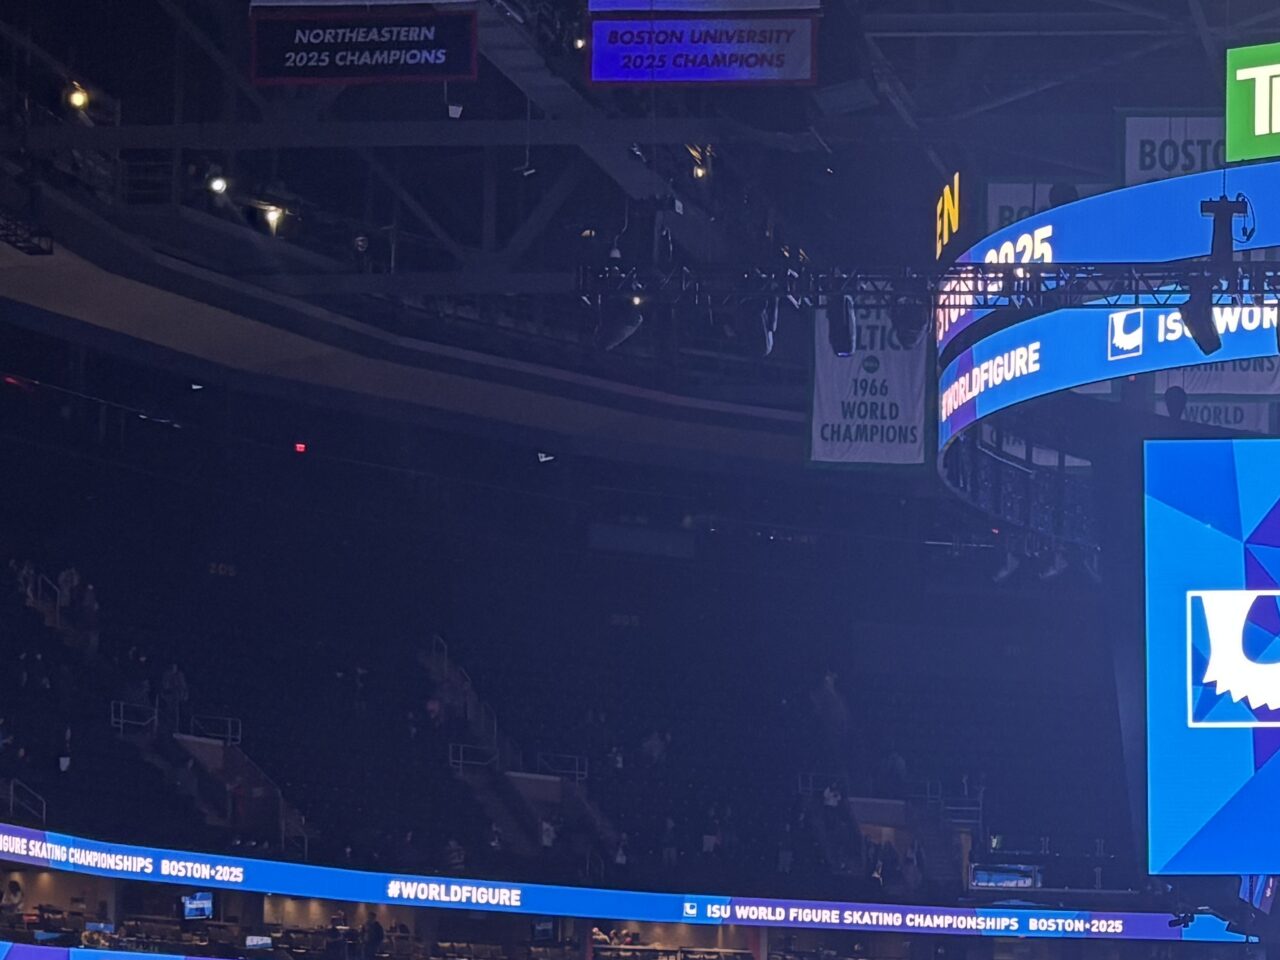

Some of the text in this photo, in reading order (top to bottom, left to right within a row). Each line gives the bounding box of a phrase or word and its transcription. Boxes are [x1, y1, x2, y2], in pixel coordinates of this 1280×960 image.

[294, 26, 435, 45] NORTHEASTERN
[607, 27, 795, 46] BOSTON UNIVERSITY
[284, 48, 447, 68] 2025 CHAMPIONS
[621, 51, 786, 70] 2025 CHAMPIONS
[1139, 139, 1225, 170] BOSTO
[853, 378, 888, 397] 1966
[841, 401, 899, 420] WORLD
[820, 423, 918, 444] CHAMPIONS
[28, 839, 67, 862] SKATING
[69, 847, 154, 874] CHAMPIONSHIPS
[387, 880, 522, 906] #WORLDFIGURE
[707, 904, 731, 919] ISU
[735, 905, 785, 922] WORLD
[789, 908, 840, 924] FIGURE
[843, 911, 902, 927] SKATING
[905, 913, 1019, 931] CHAMPIONSHIPS
